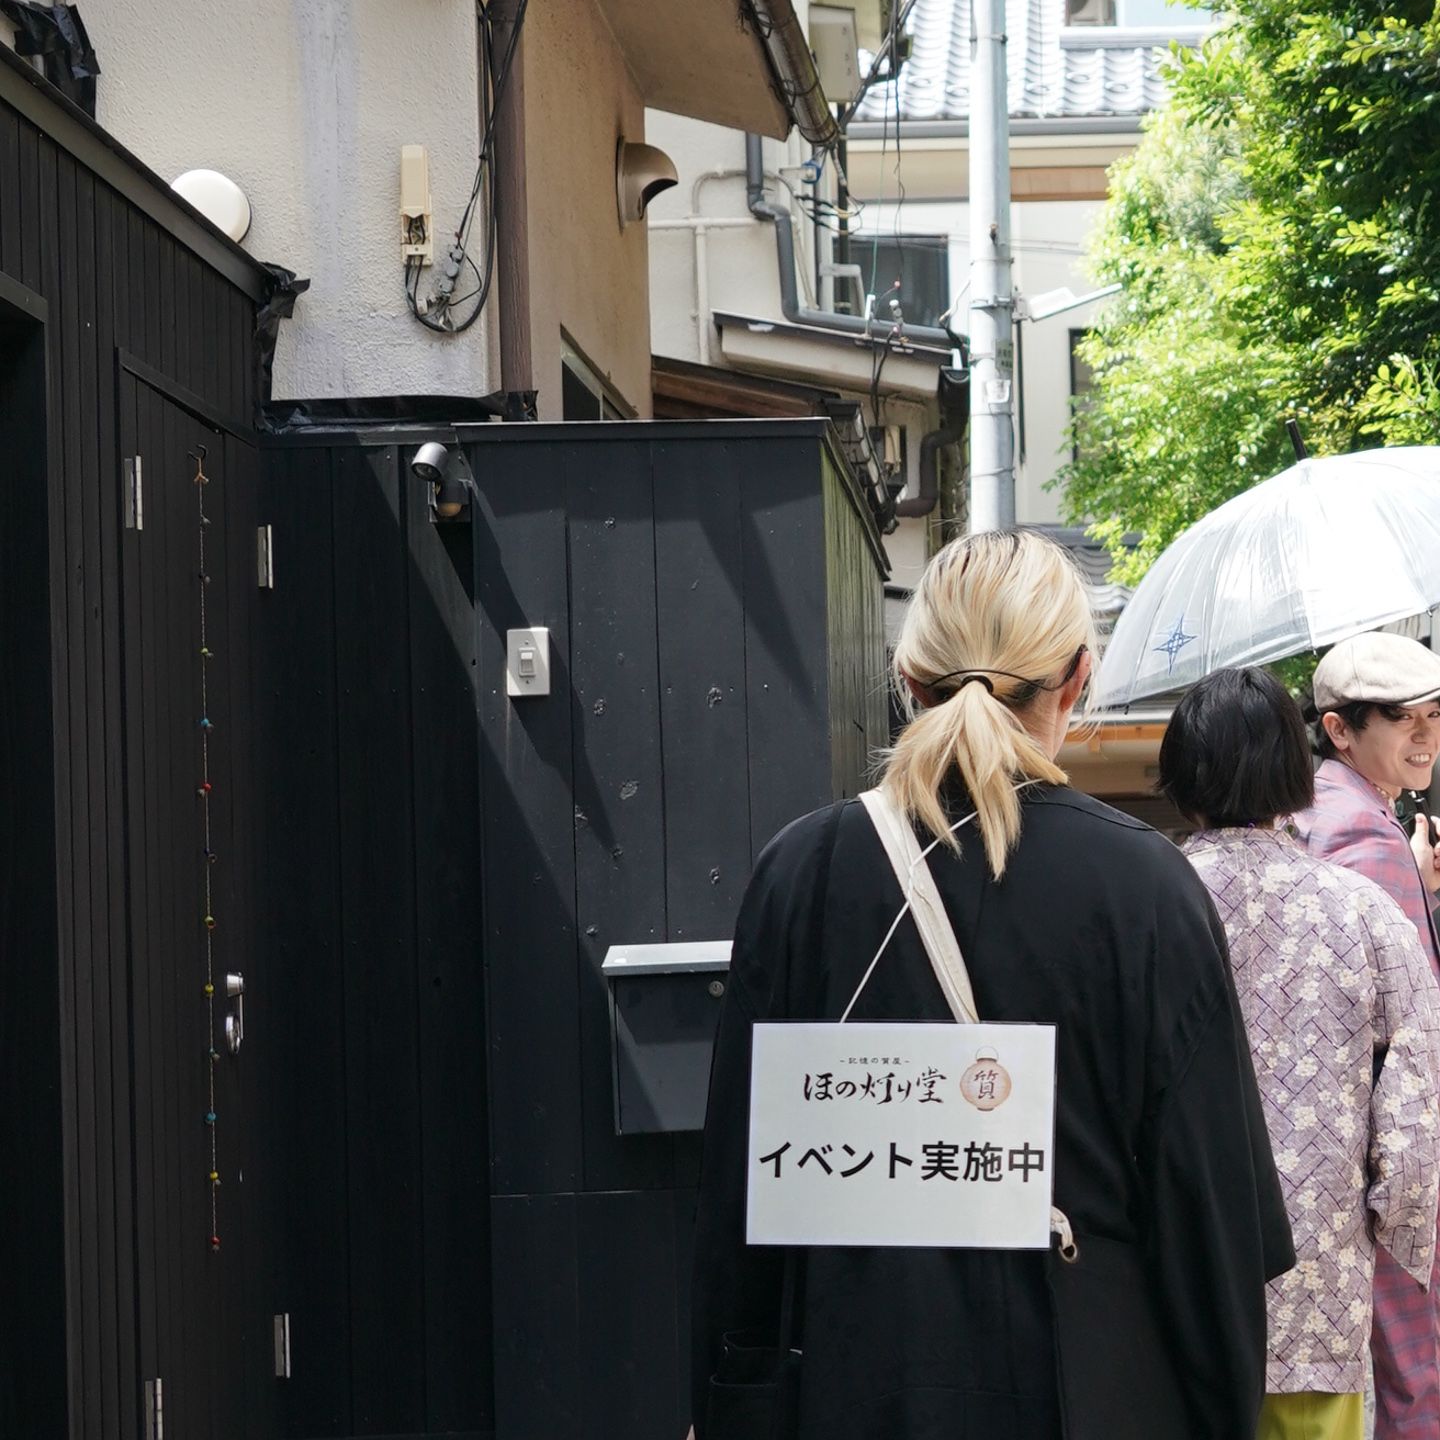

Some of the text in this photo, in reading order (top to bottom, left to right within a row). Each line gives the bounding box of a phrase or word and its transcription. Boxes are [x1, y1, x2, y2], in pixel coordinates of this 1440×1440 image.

[803, 1066, 947, 1105] ほの灯り堂
[974, 1070, 999, 1099] 質
[759, 1140, 1045, 1183] イベント実施中
